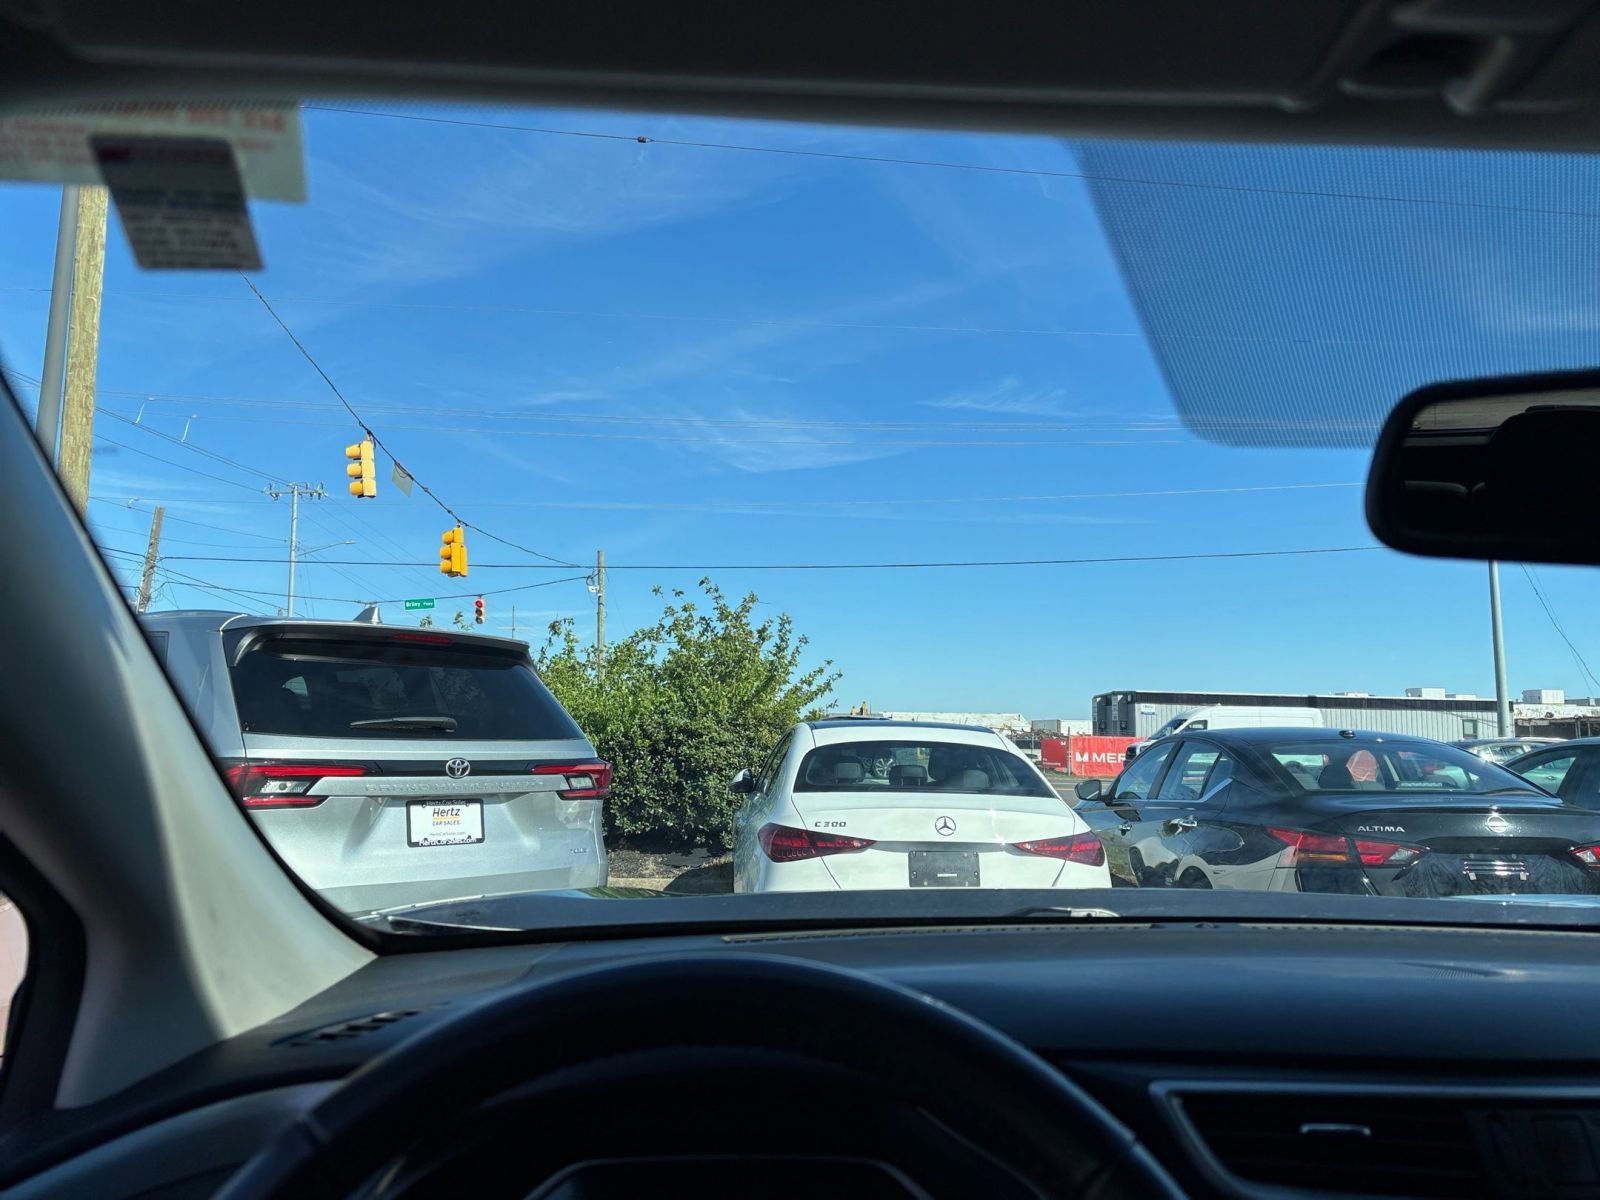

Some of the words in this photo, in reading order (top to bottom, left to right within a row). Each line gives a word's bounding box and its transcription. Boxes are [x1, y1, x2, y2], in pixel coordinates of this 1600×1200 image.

[432, 807, 461, 817] Hertz
[1357, 825, 1406, 833] ALTIMA
[419, 838, 477, 847] HertzCarSales.com
